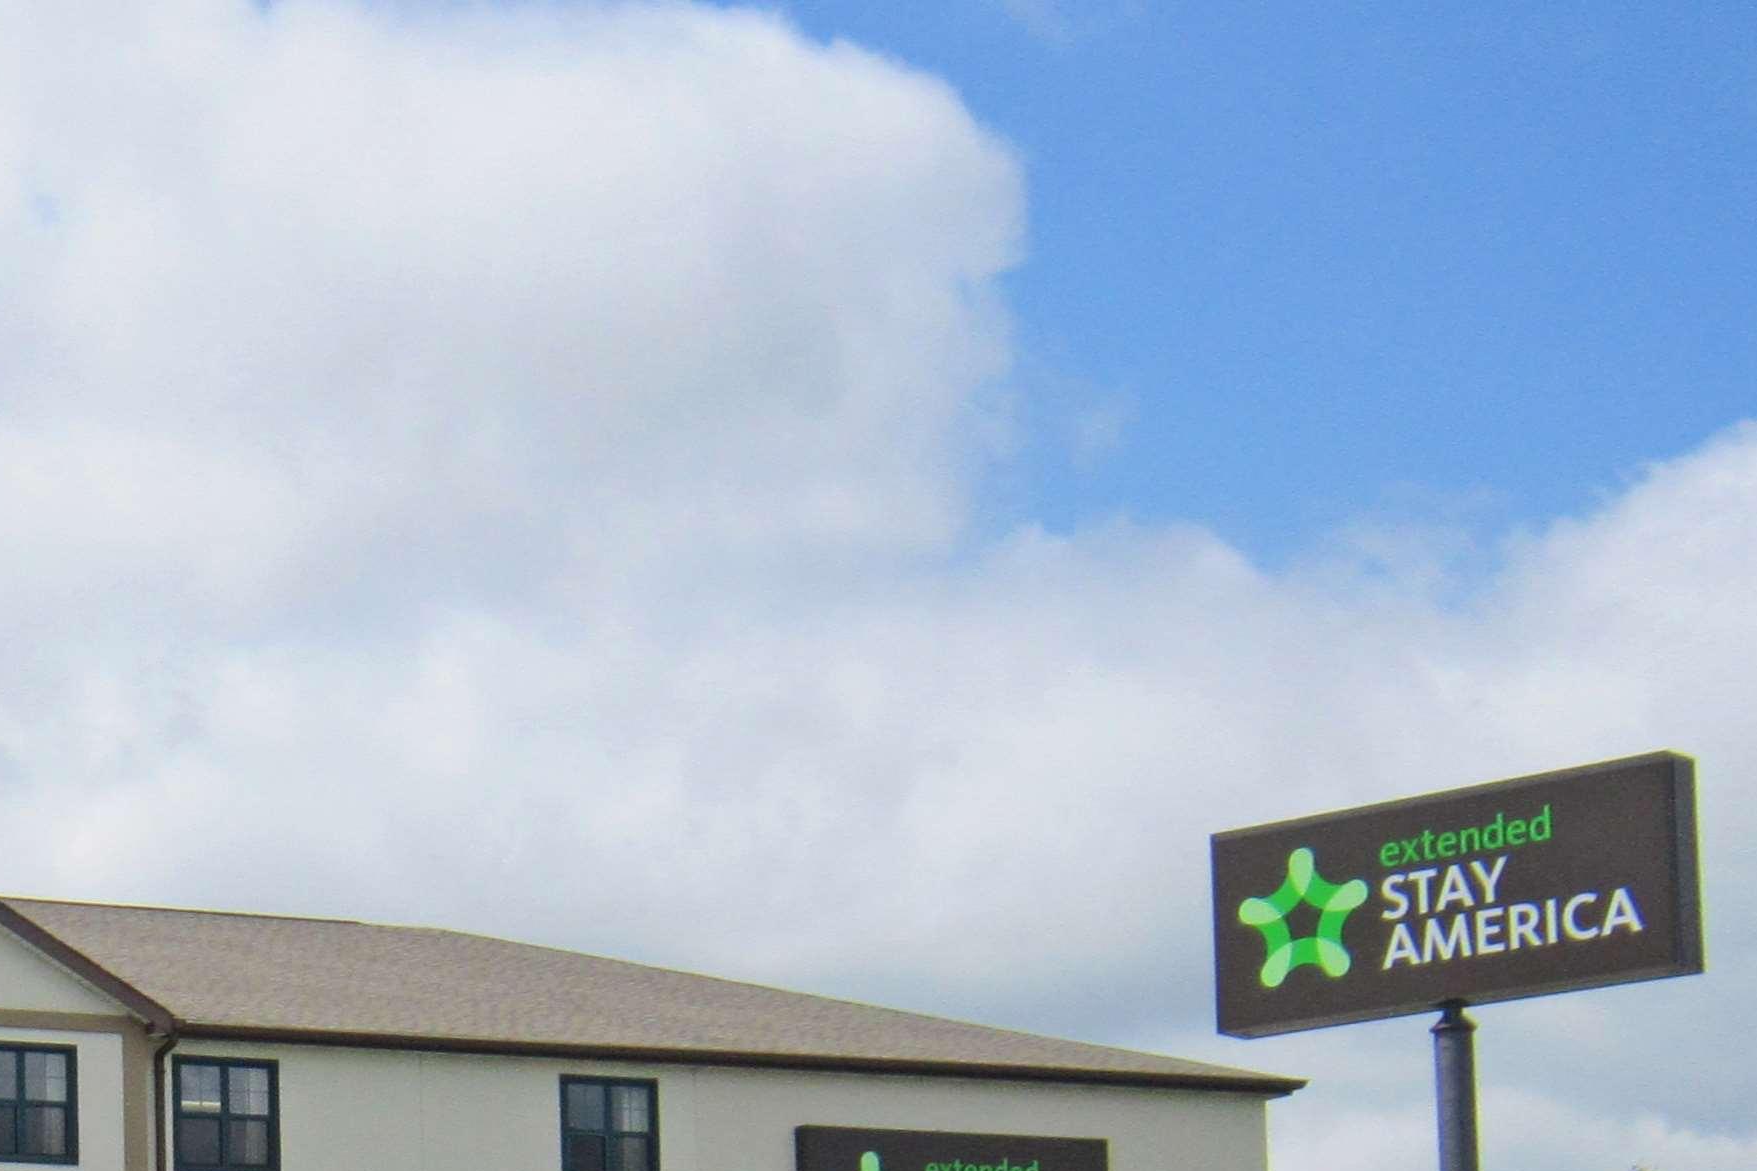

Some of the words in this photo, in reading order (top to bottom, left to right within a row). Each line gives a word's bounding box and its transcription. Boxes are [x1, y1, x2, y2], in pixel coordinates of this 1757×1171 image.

[1380, 805, 1553, 867] extended
[1381, 855, 1509, 921] STAY
[1382, 887, 1643, 970] AMERICA
